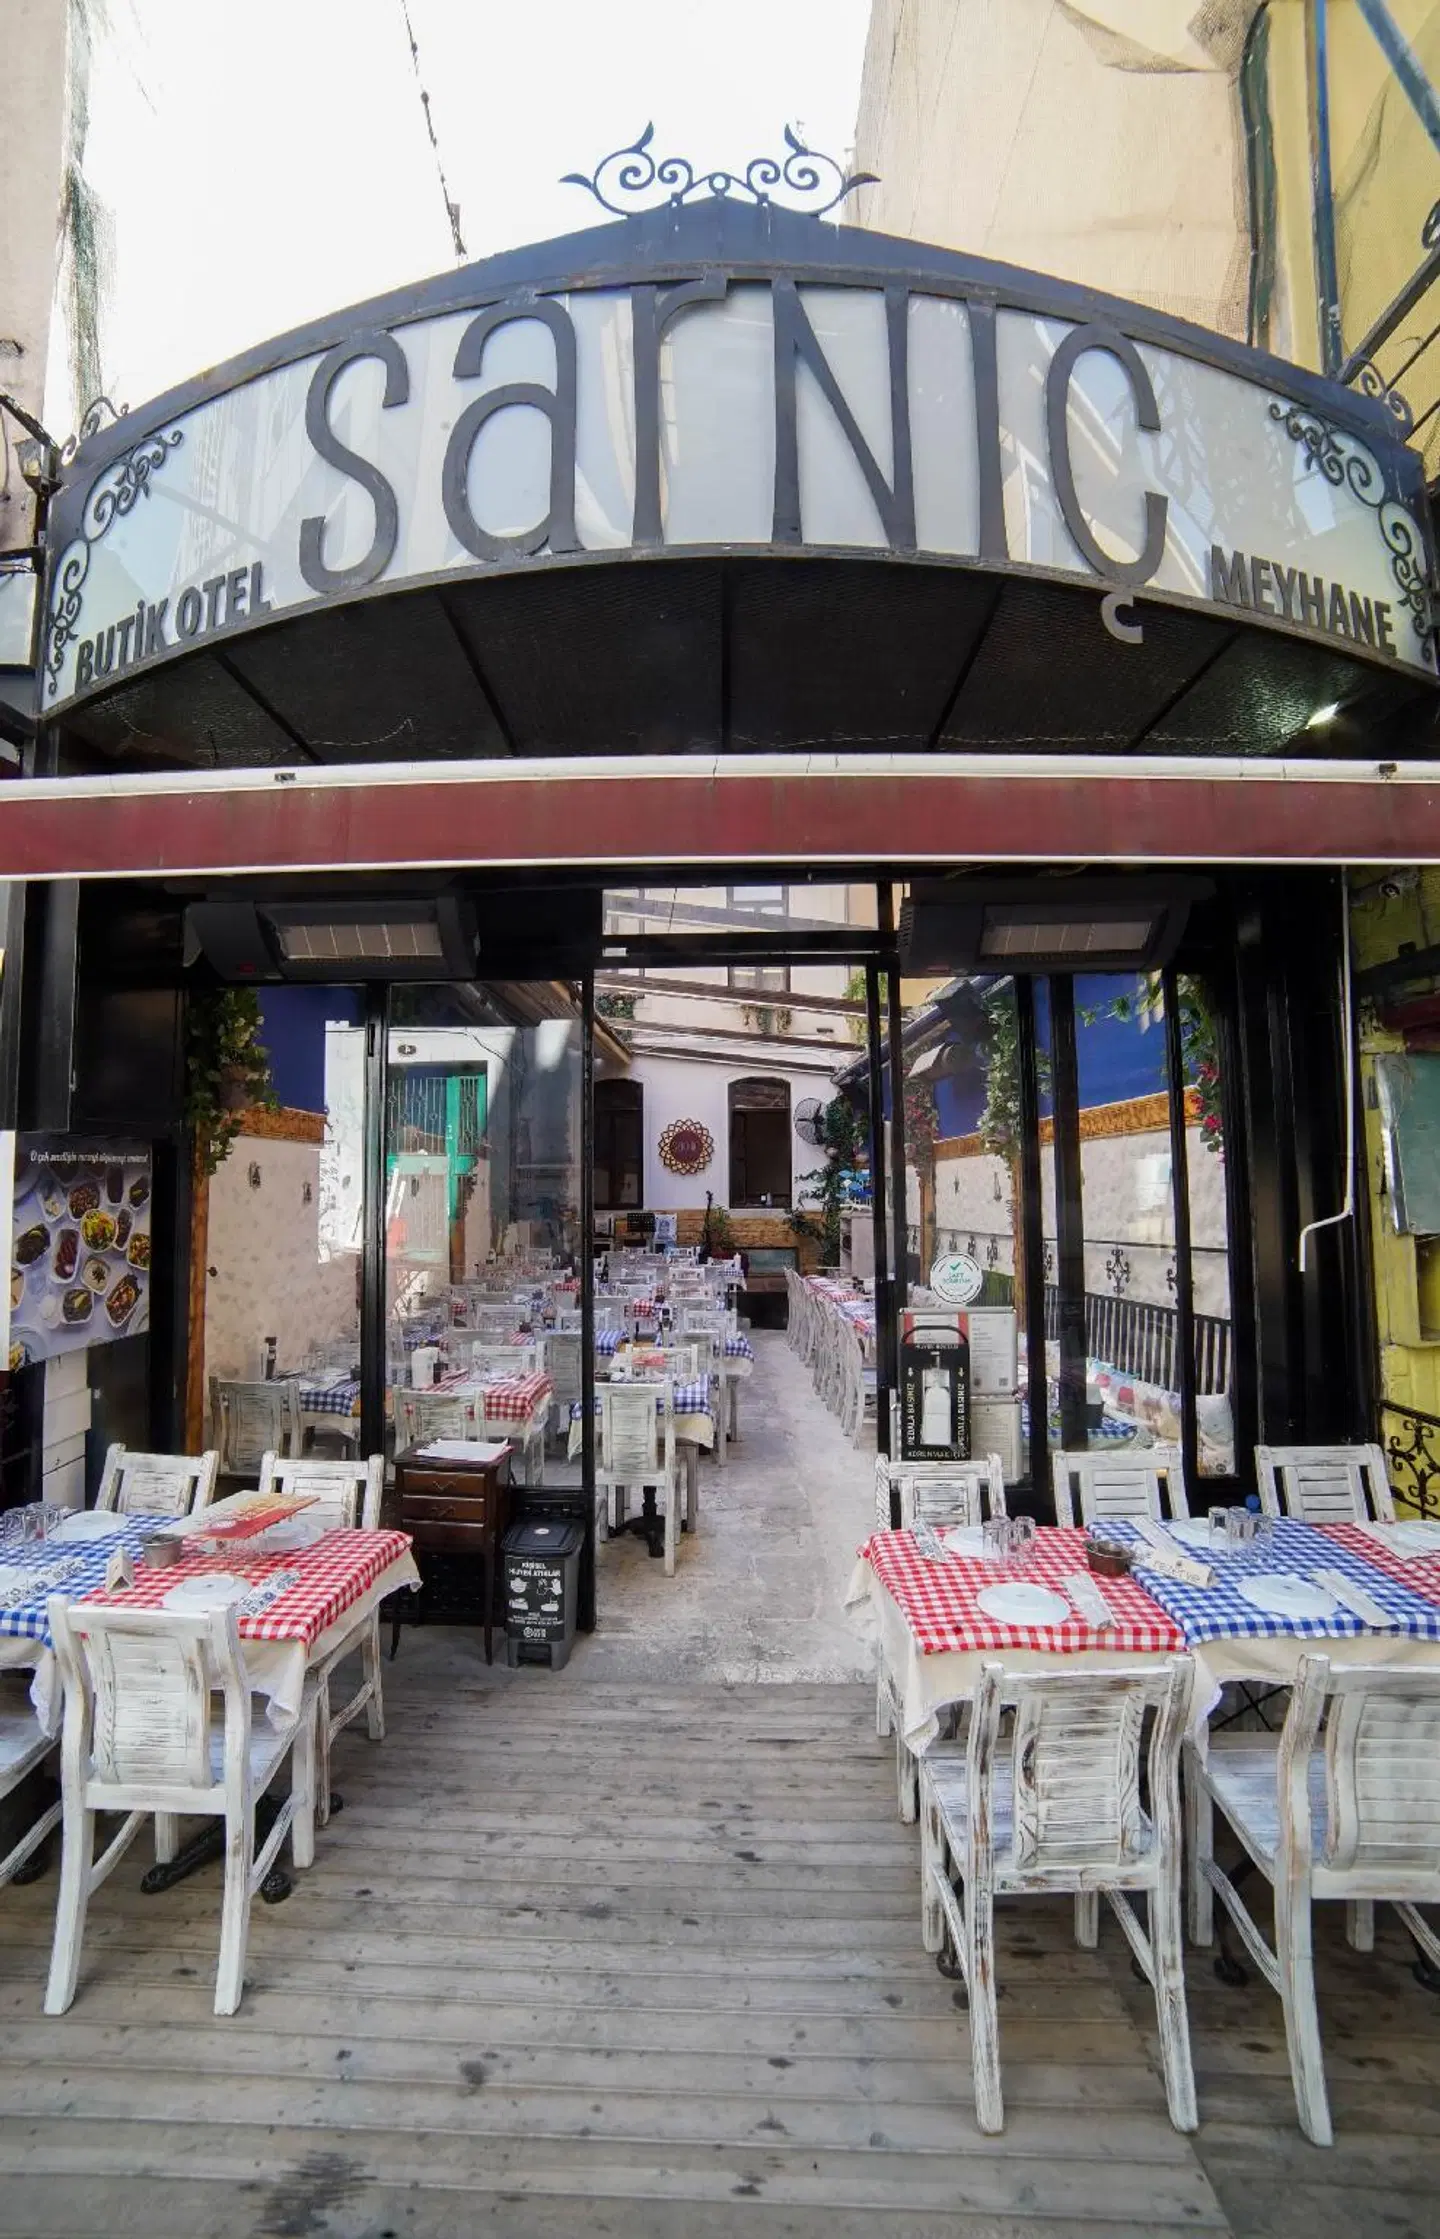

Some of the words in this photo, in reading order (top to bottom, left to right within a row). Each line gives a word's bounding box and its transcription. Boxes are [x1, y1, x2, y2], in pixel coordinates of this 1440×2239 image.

[174, 560, 271, 641] OTEL
[1211, 544, 1398, 658] MEYHANE
[906, 1382, 915, 1414] BASINIZ
[957, 1382, 966, 1414] BASINIZ
[906, 1415, 915, 1446] PEDALA
